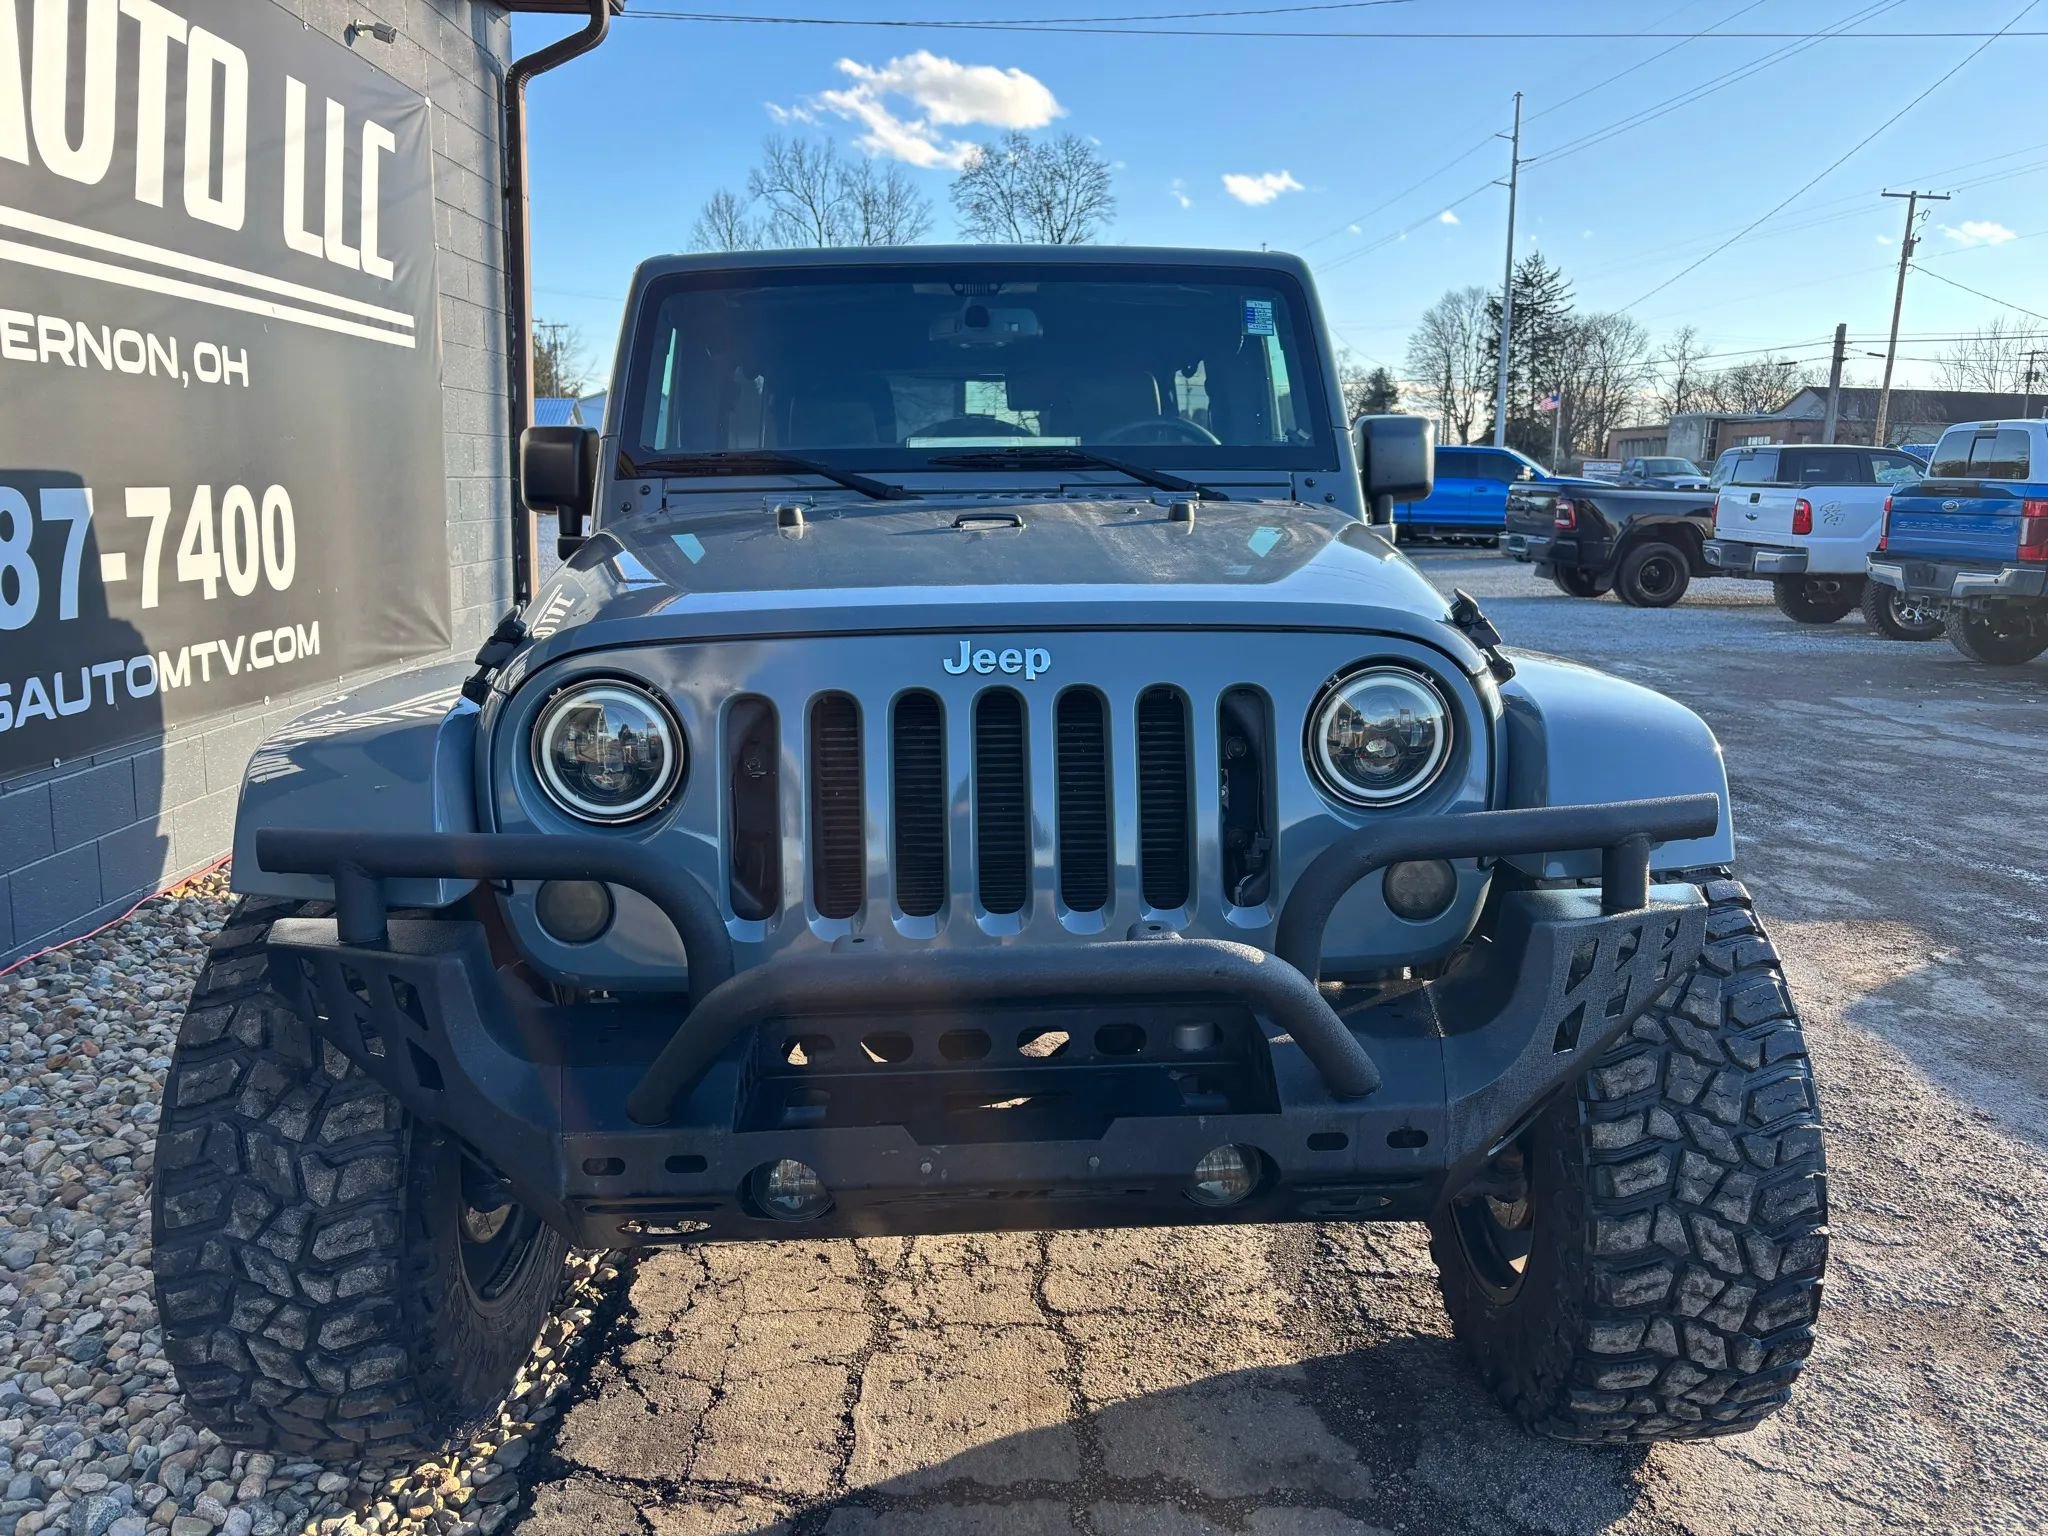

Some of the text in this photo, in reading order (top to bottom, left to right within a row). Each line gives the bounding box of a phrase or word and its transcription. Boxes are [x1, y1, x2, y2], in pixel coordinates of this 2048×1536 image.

[283, 75, 396, 281] LLC
[0, 484, 297, 631] 87-7400
[943, 640, 1051, 681] Jeep
